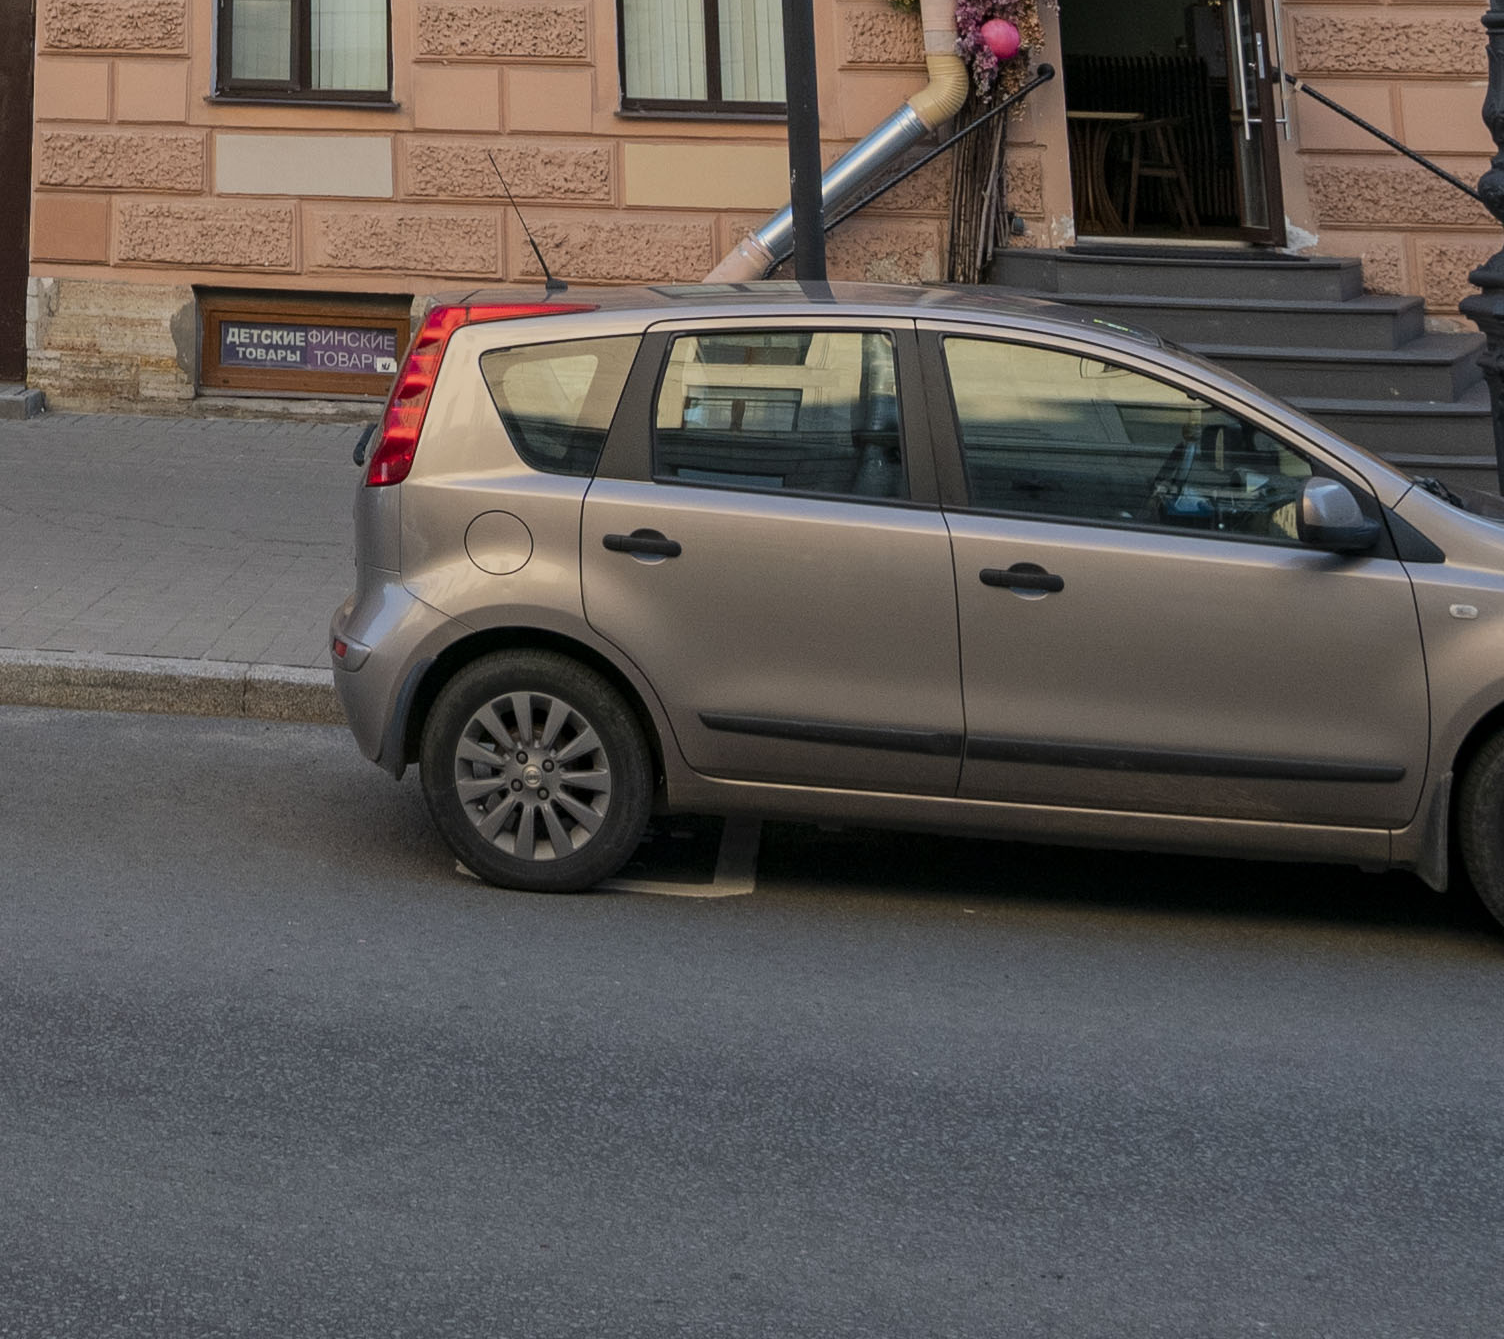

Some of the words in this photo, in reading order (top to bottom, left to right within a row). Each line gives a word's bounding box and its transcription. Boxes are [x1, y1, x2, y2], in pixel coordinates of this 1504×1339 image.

[226, 327, 306, 346] ДЕТСКИЕ
[308, 329, 395, 351] ФИНСКИЕ
[236, 347, 300, 362] ТОВАРЫ
